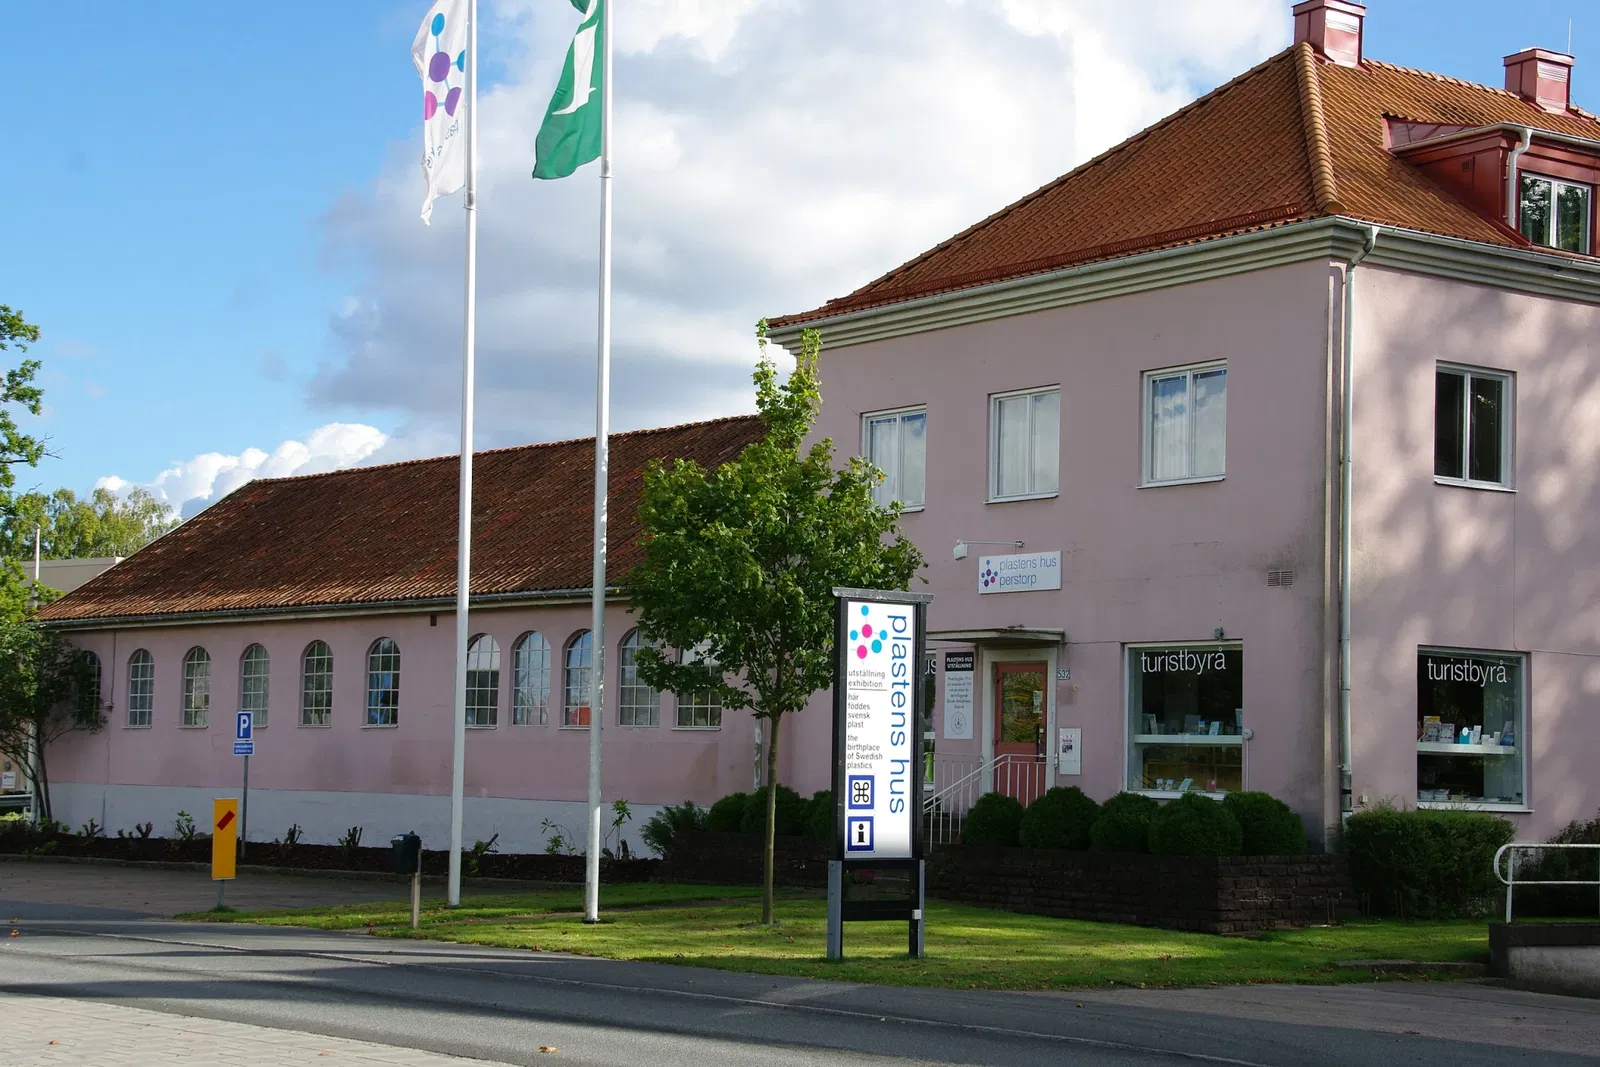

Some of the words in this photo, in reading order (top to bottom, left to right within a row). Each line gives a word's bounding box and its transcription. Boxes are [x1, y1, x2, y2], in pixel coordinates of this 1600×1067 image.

[1000, 558, 1037, 573] plastens
[1039, 556, 1057, 568] hus
[1000, 574, 1037, 588] perstorp
[1141, 646, 1226, 675] turistbyrå
[848, 669, 886, 679] utställning
[1058, 669, 1070, 680] 532
[1427, 658, 1507, 687] turistbyrå
[848, 680, 883, 688] exhibition
[887, 615, 912, 746] plastens
[848, 693, 859, 701] här
[848, 702, 871, 710] föddes
[847, 711, 871, 719] svensk
[240, 715, 249, 737] P
[847, 720, 864, 729] plast
[847, 743, 880, 752] birthplace
[855, 752, 883, 761] Swedish
[847, 761, 873, 770] plastics
[889, 759, 910, 814] hus
